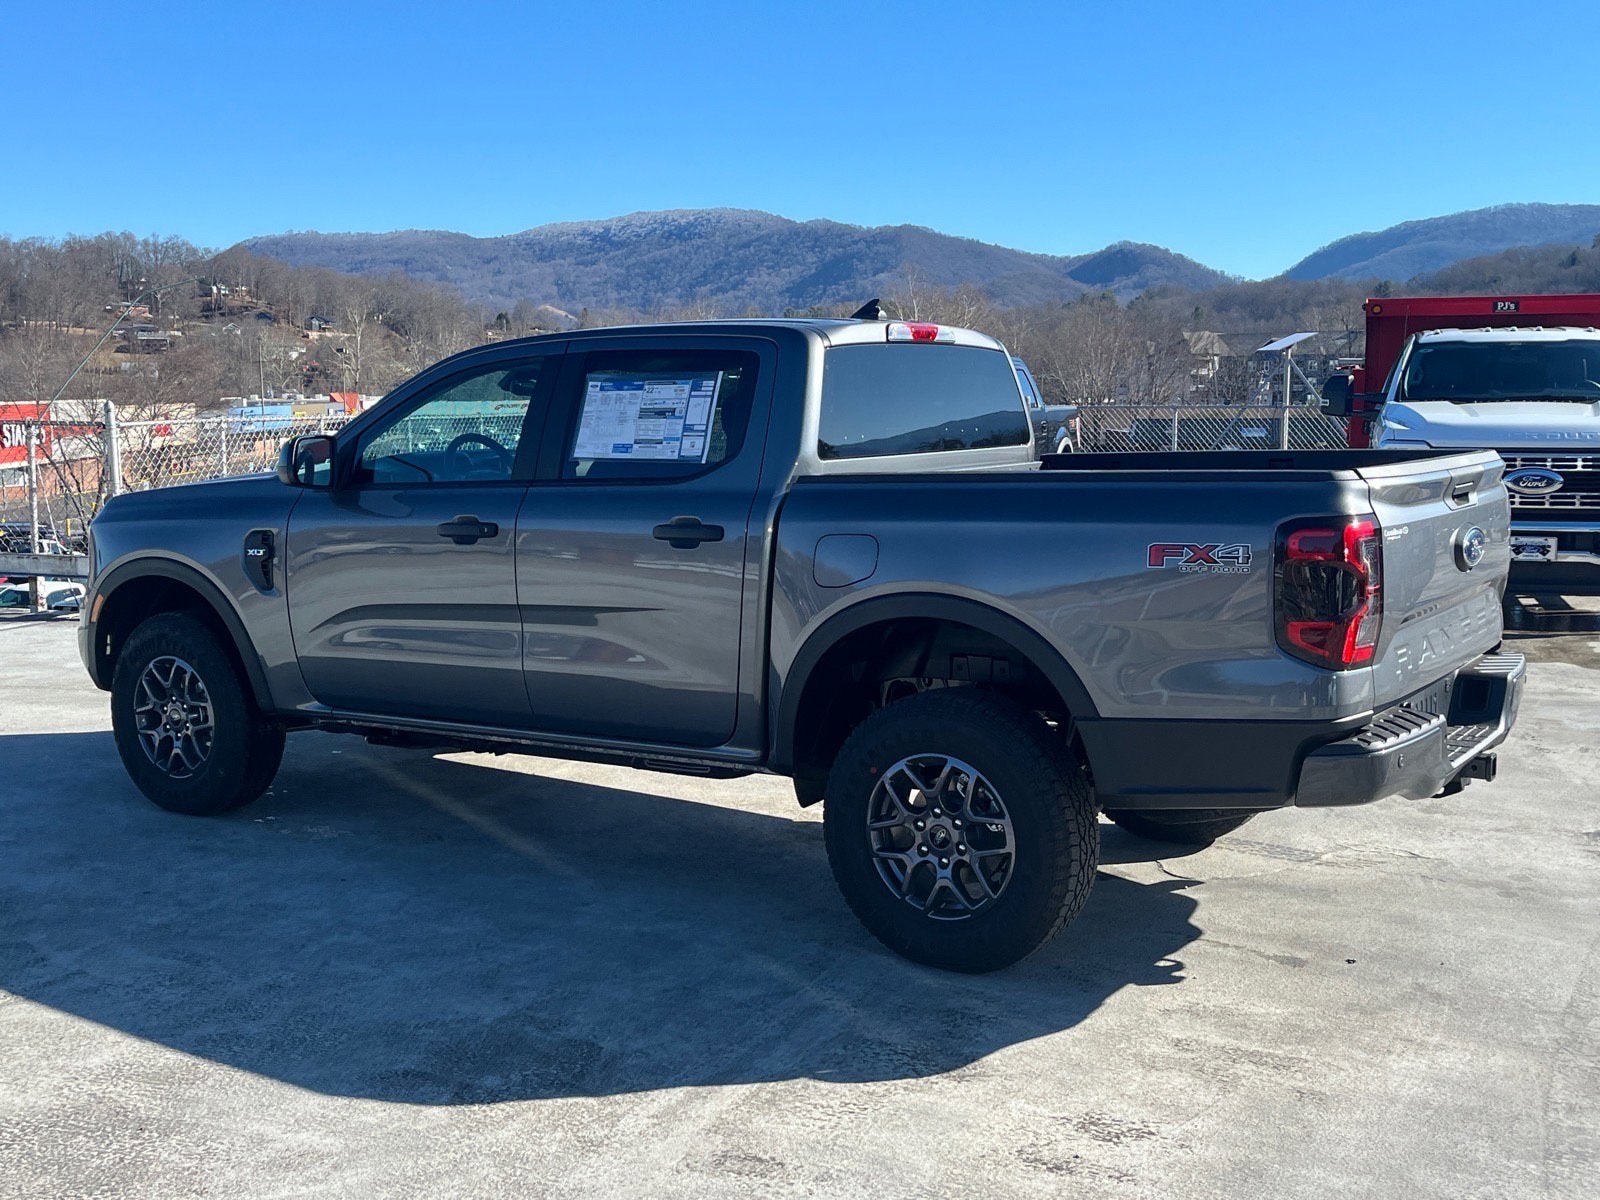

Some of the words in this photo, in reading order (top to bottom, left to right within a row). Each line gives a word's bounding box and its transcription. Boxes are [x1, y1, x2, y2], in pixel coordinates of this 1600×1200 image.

[1497, 301, 1515, 310] PJ's
[646, 386, 655, 394] 22
[1546, 431, 1600, 440] DUT
[1519, 475, 1548, 487] Ford
[1147, 542, 1252, 568] FX4
[1178, 565, 1208, 573] OFF
[1211, 566, 1251, 574] ROAD
[1394, 598, 1498, 676] RANGER
